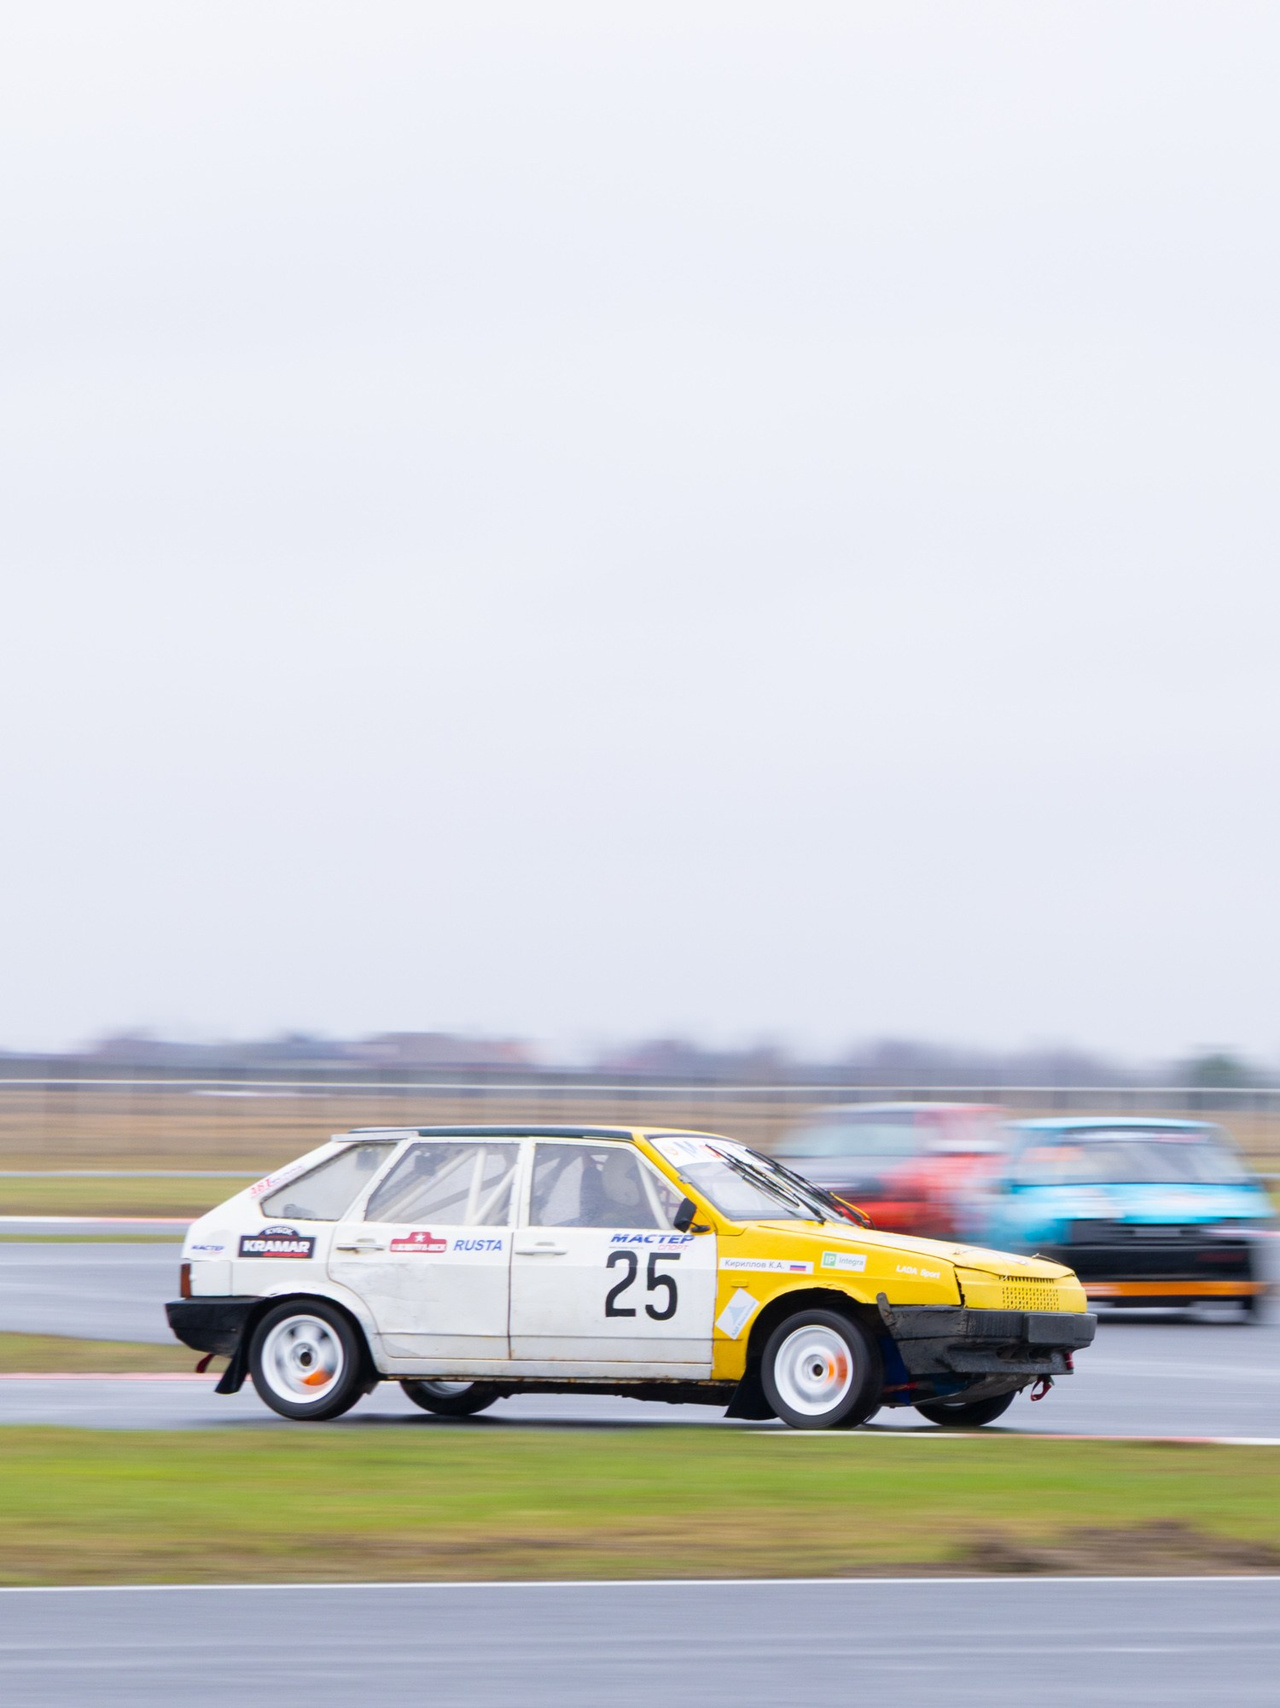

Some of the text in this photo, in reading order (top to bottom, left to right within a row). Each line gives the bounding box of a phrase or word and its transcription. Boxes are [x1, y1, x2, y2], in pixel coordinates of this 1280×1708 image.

[610, 1233, 695, 1244] МАСТЕР
[242, 1240, 311, 1253] KRAMAR
[453, 1240, 503, 1251] RUSTA
[724, 1258, 785, 1269] Кириллов К.А.
[896, 1264, 941, 1279] LADA Sport
[605, 1250, 682, 1321] 25
